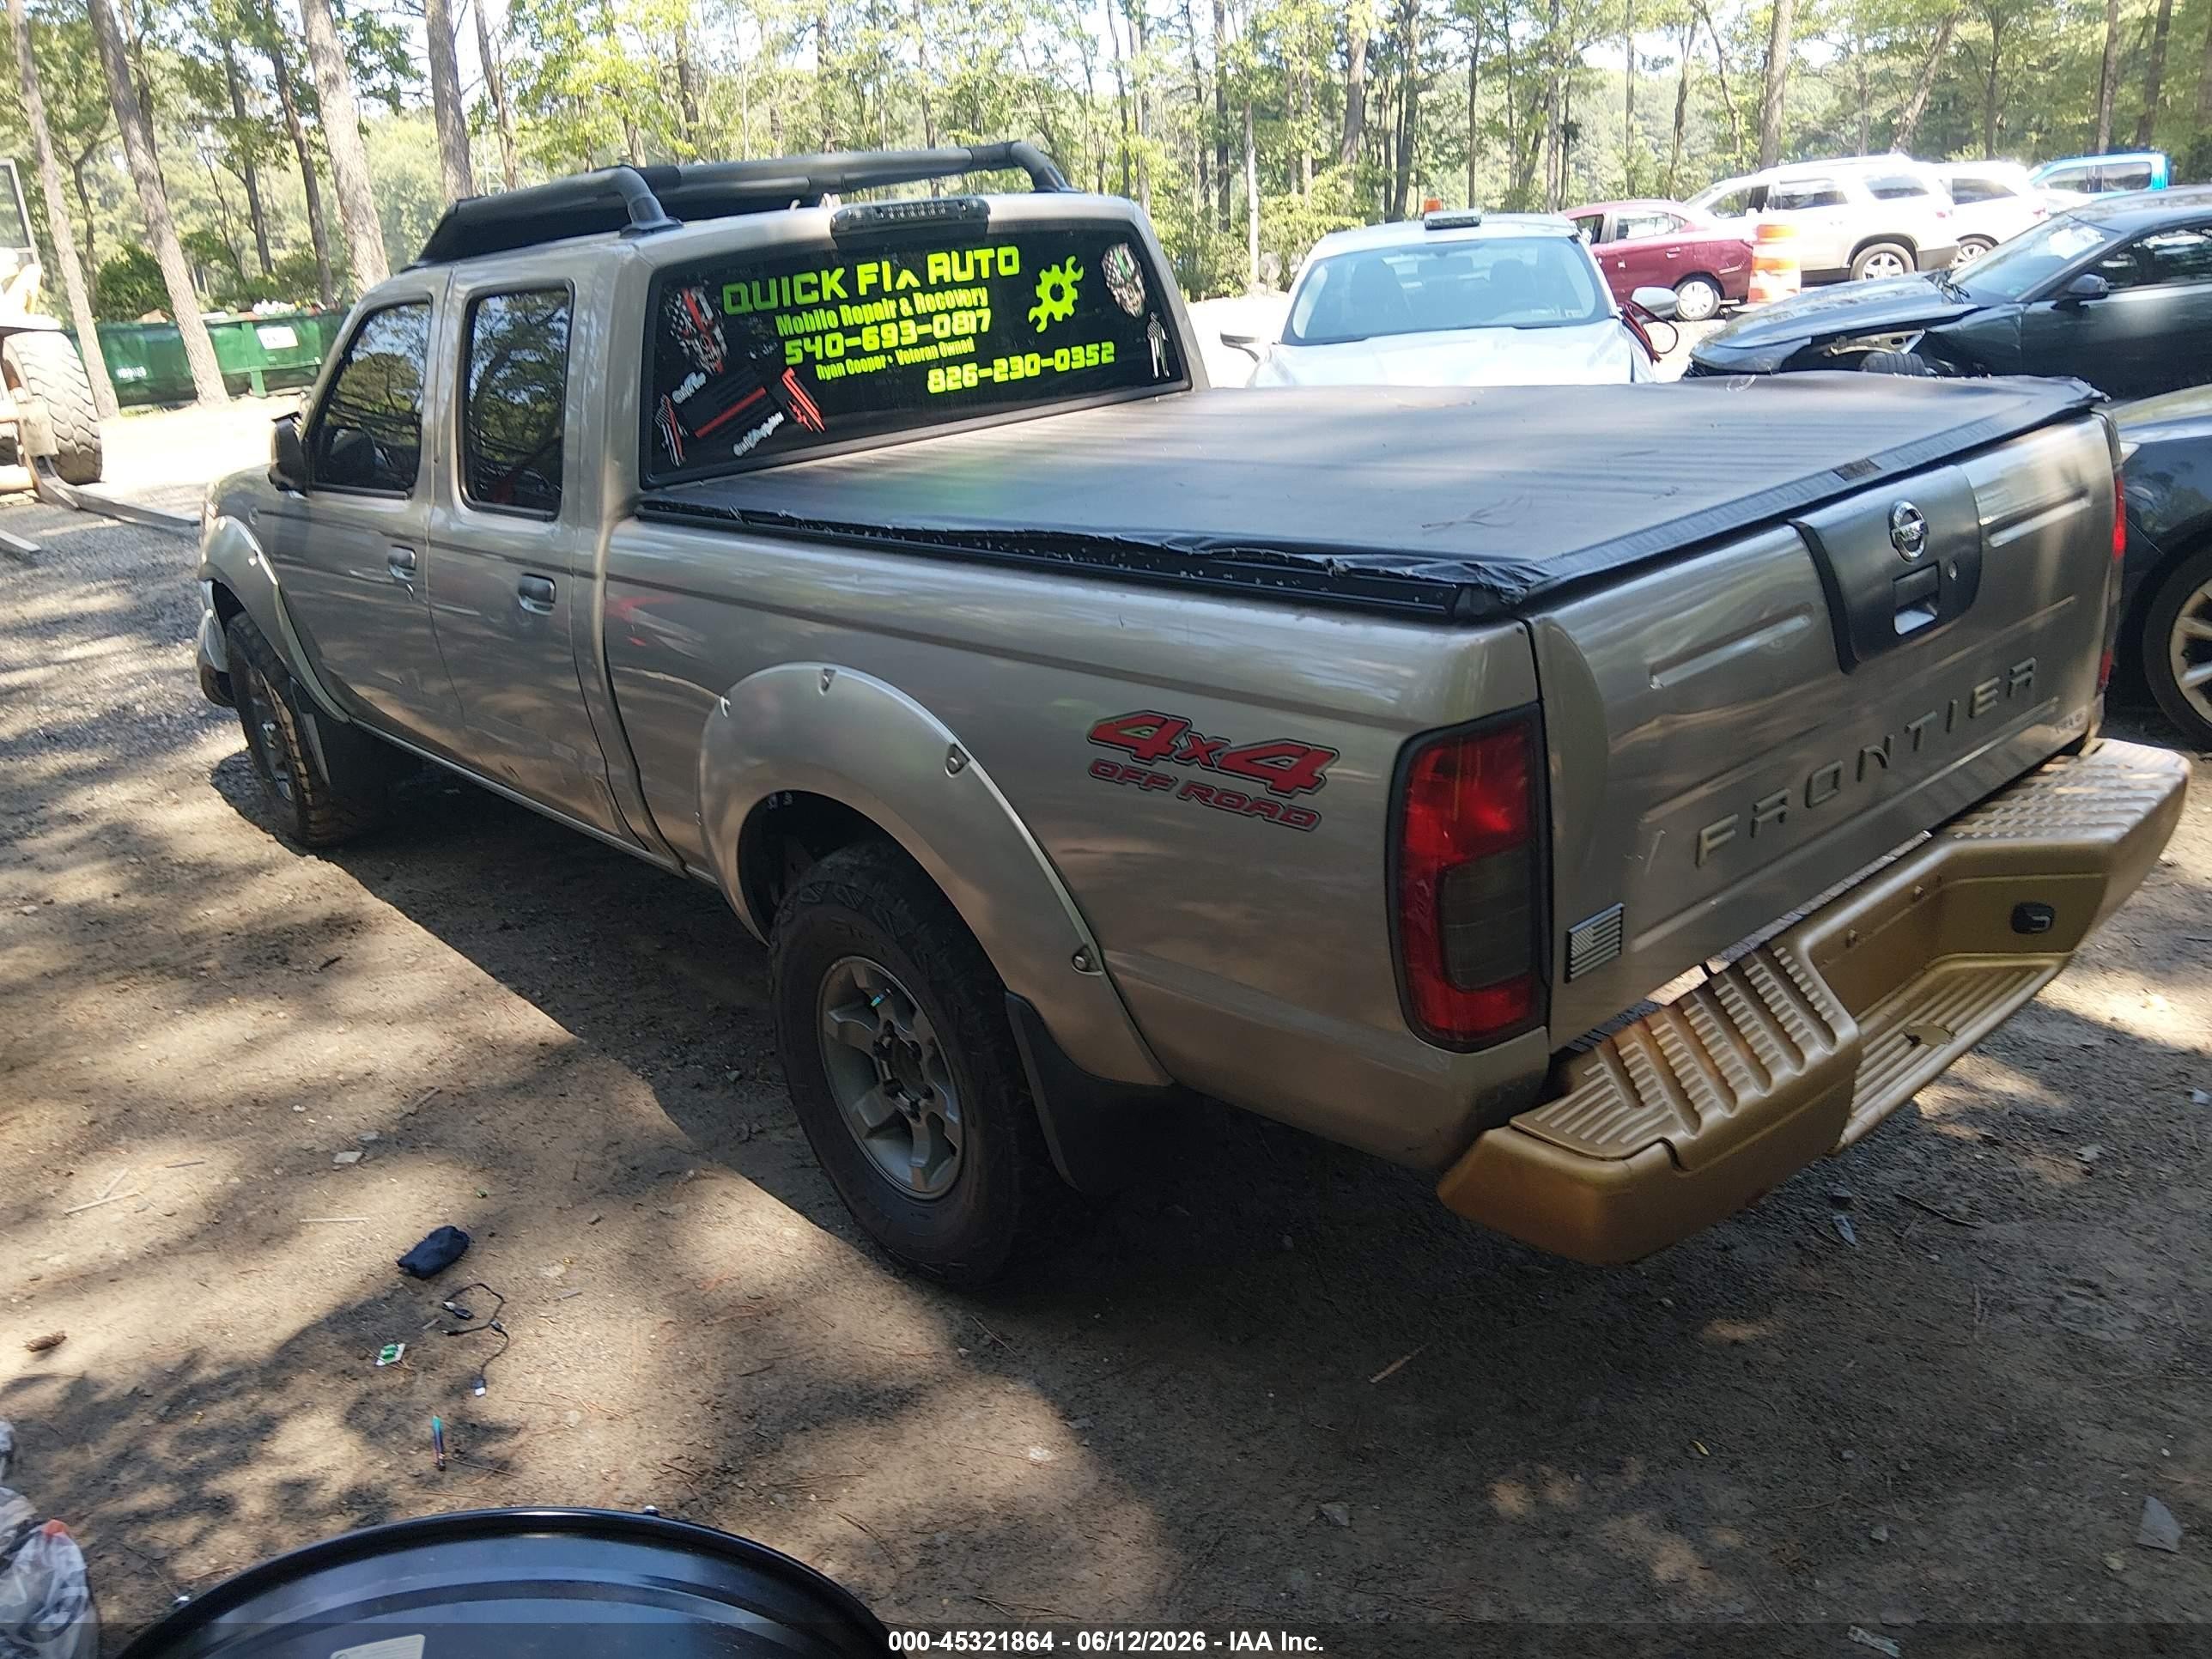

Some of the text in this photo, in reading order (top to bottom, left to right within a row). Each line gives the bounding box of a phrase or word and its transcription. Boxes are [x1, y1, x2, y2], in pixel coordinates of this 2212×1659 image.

[723, 267, 848, 315] QUICK
[927, 246, 1020, 285] AUTO
[775, 287, 989, 337] Mobile Repair & Recovery
[784, 308, 992, 366] 540-693-0817
[816, 337, 975, 381] Ryan Cooper Veteran Owned
[927, 341, 1115, 394] 826-230-0352
[1086, 709, 1340, 799] 4x4
[1697, 656, 2037, 869] FRONTIER
[1088, 758, 1322, 833] OFF ROAD
